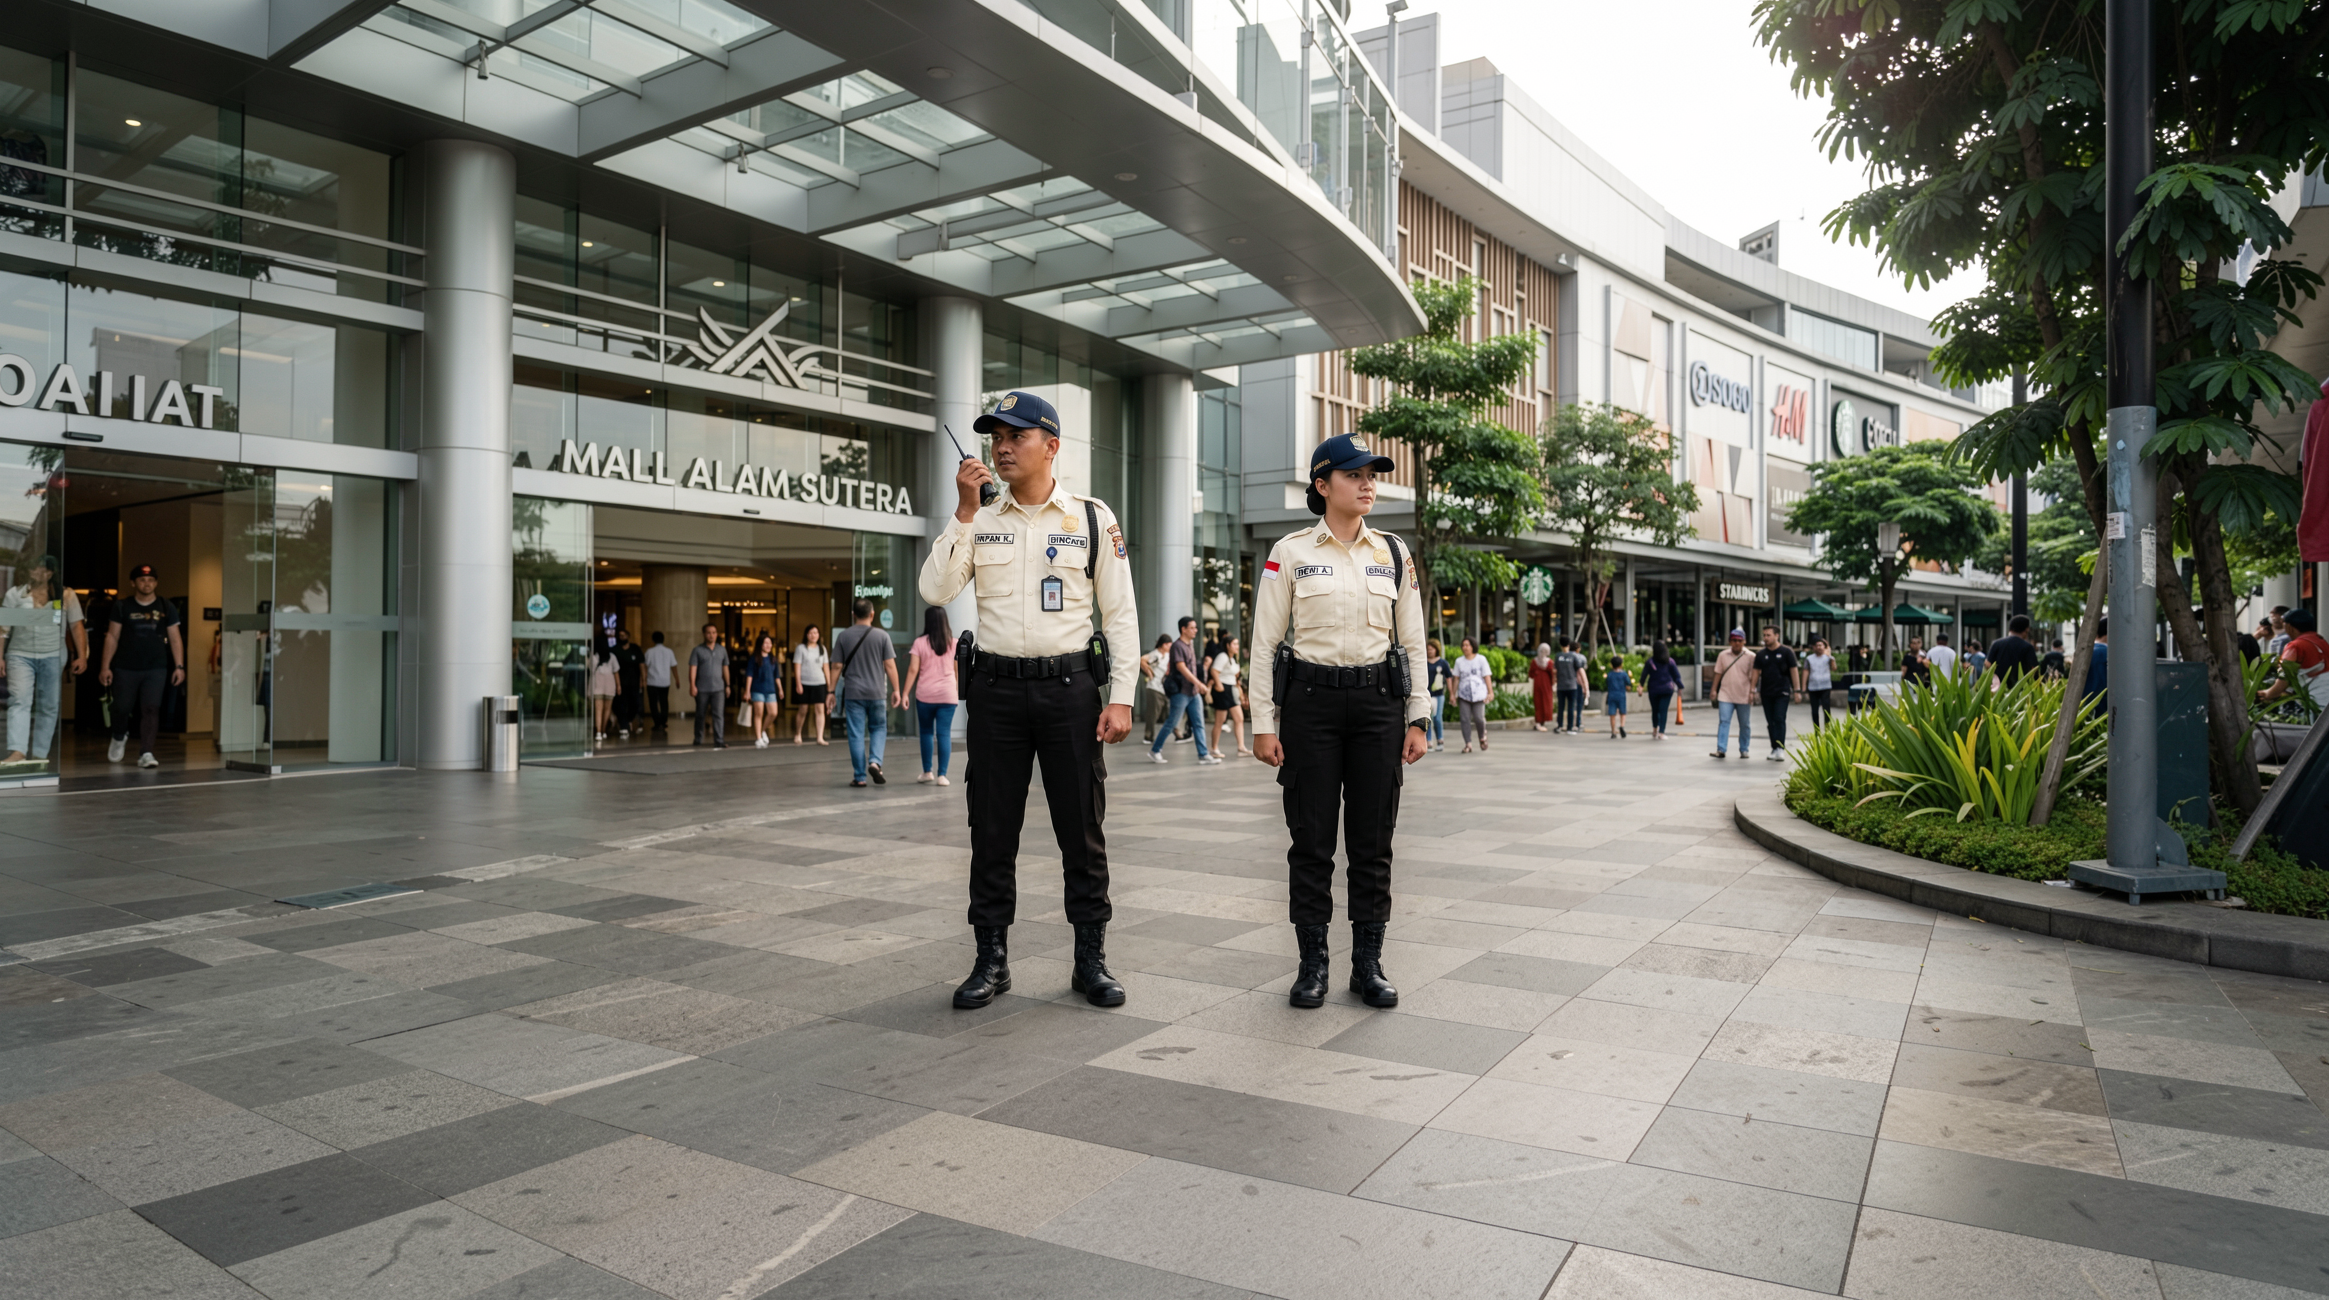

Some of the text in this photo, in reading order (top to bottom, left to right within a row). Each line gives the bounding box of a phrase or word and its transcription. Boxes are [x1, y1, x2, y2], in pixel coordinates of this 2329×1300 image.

[560, 438, 913, 516] MALL ALAM SUTERA
